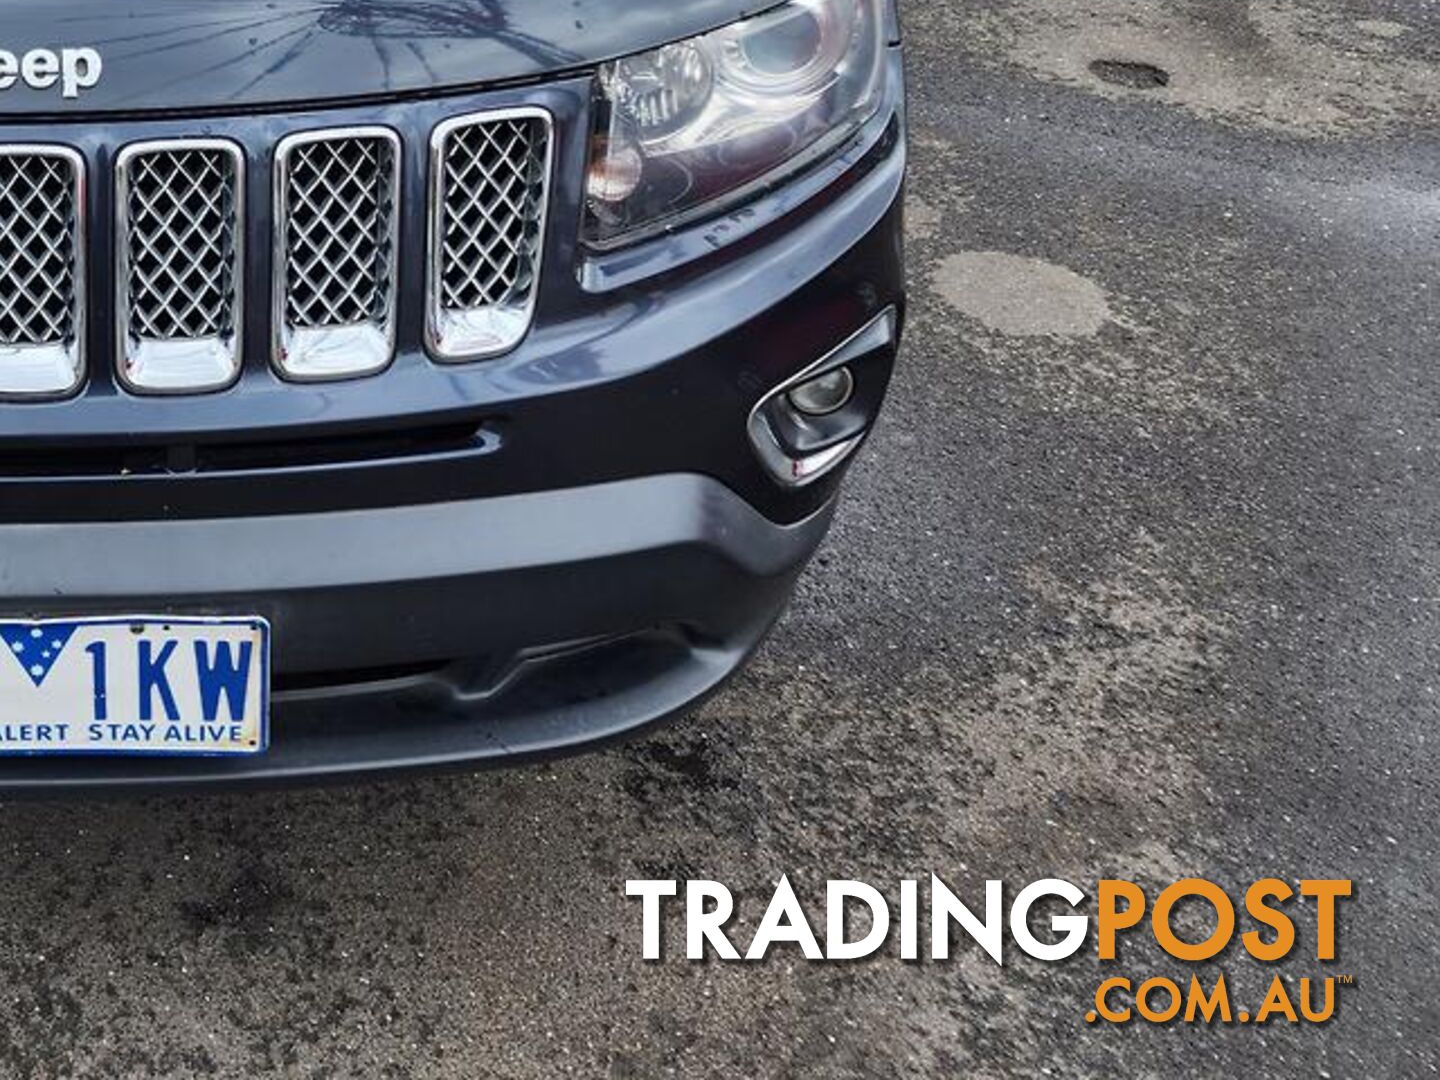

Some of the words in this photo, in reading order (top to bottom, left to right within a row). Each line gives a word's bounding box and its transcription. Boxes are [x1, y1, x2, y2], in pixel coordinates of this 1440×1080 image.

[84, 639, 254, 721] 1KW
[88, 724, 156, 743] STAY
[164, 723, 244, 743] ALIVE
